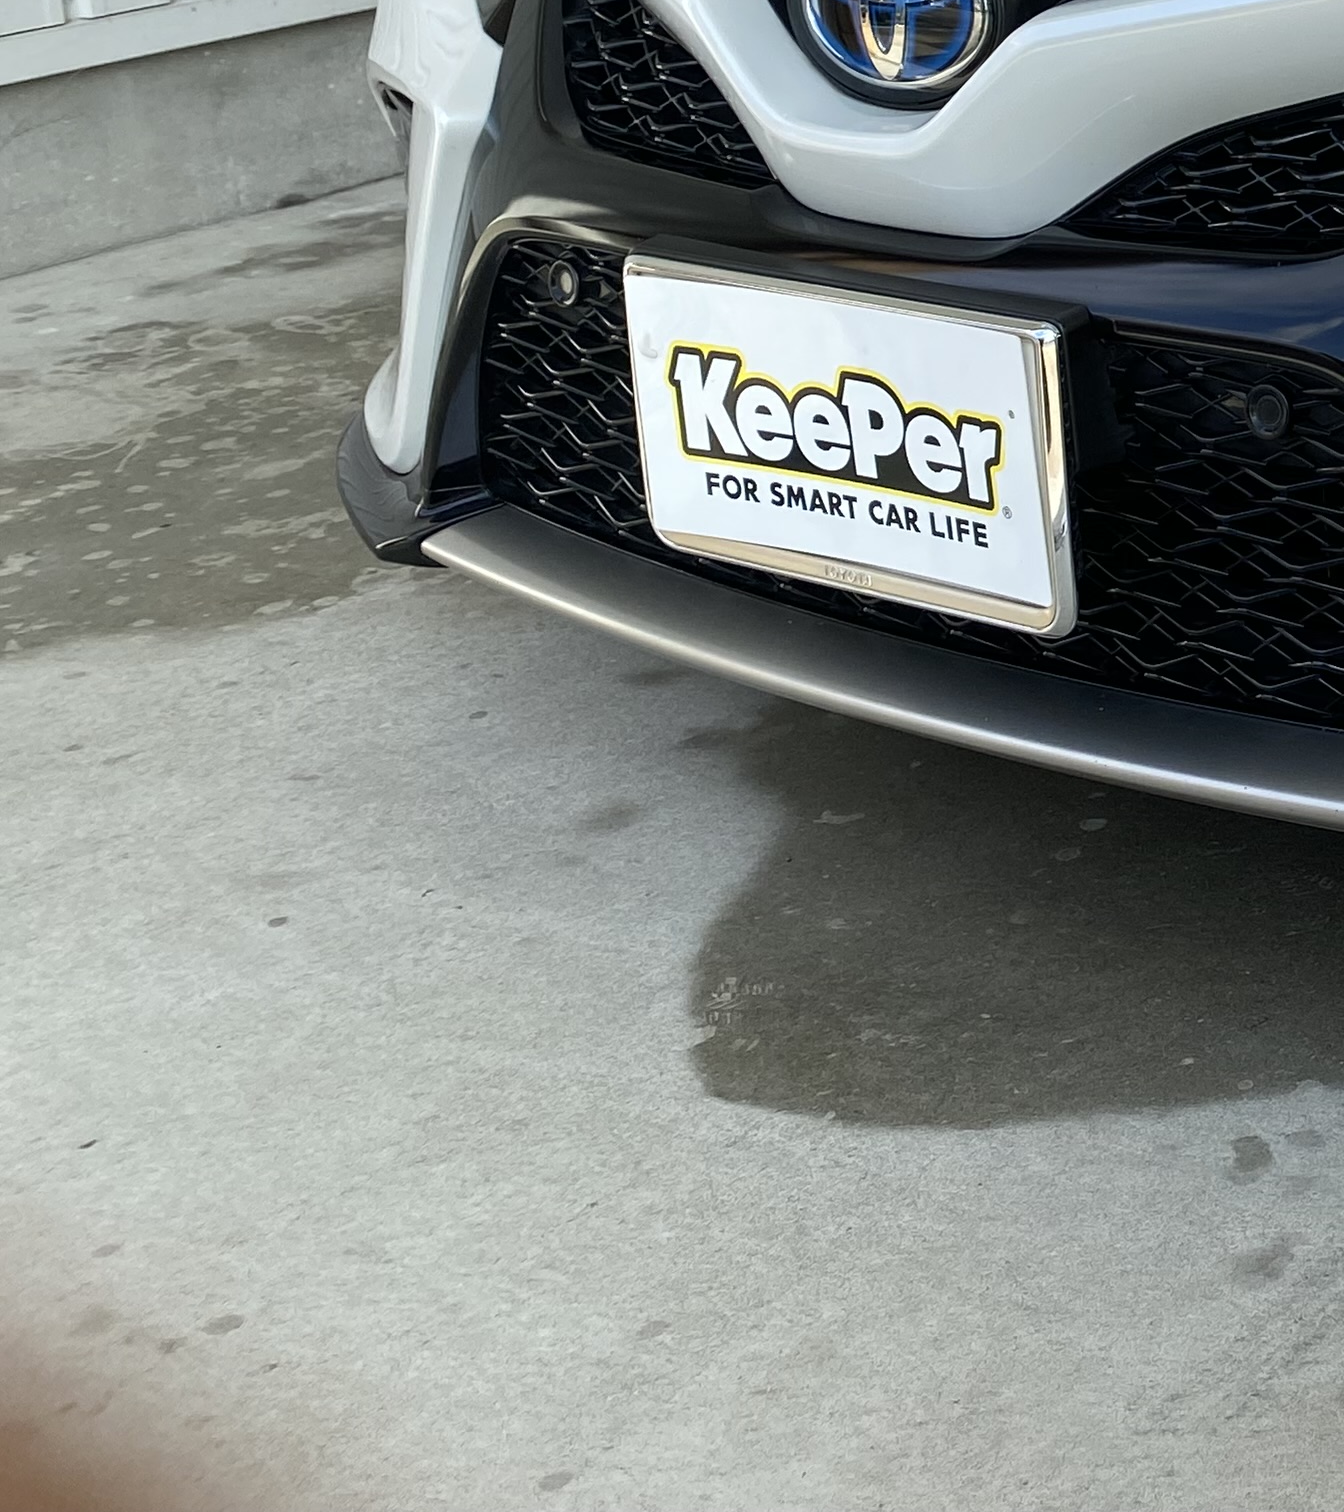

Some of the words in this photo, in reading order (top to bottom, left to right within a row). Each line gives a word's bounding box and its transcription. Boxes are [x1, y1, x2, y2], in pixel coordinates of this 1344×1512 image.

[670, 345, 1002, 511] KeePer
[705, 472, 760, 503] FOR
[770, 481, 858, 519] SMART
[868, 499, 921, 533] CAR
[928, 511, 989, 549] LIFE
